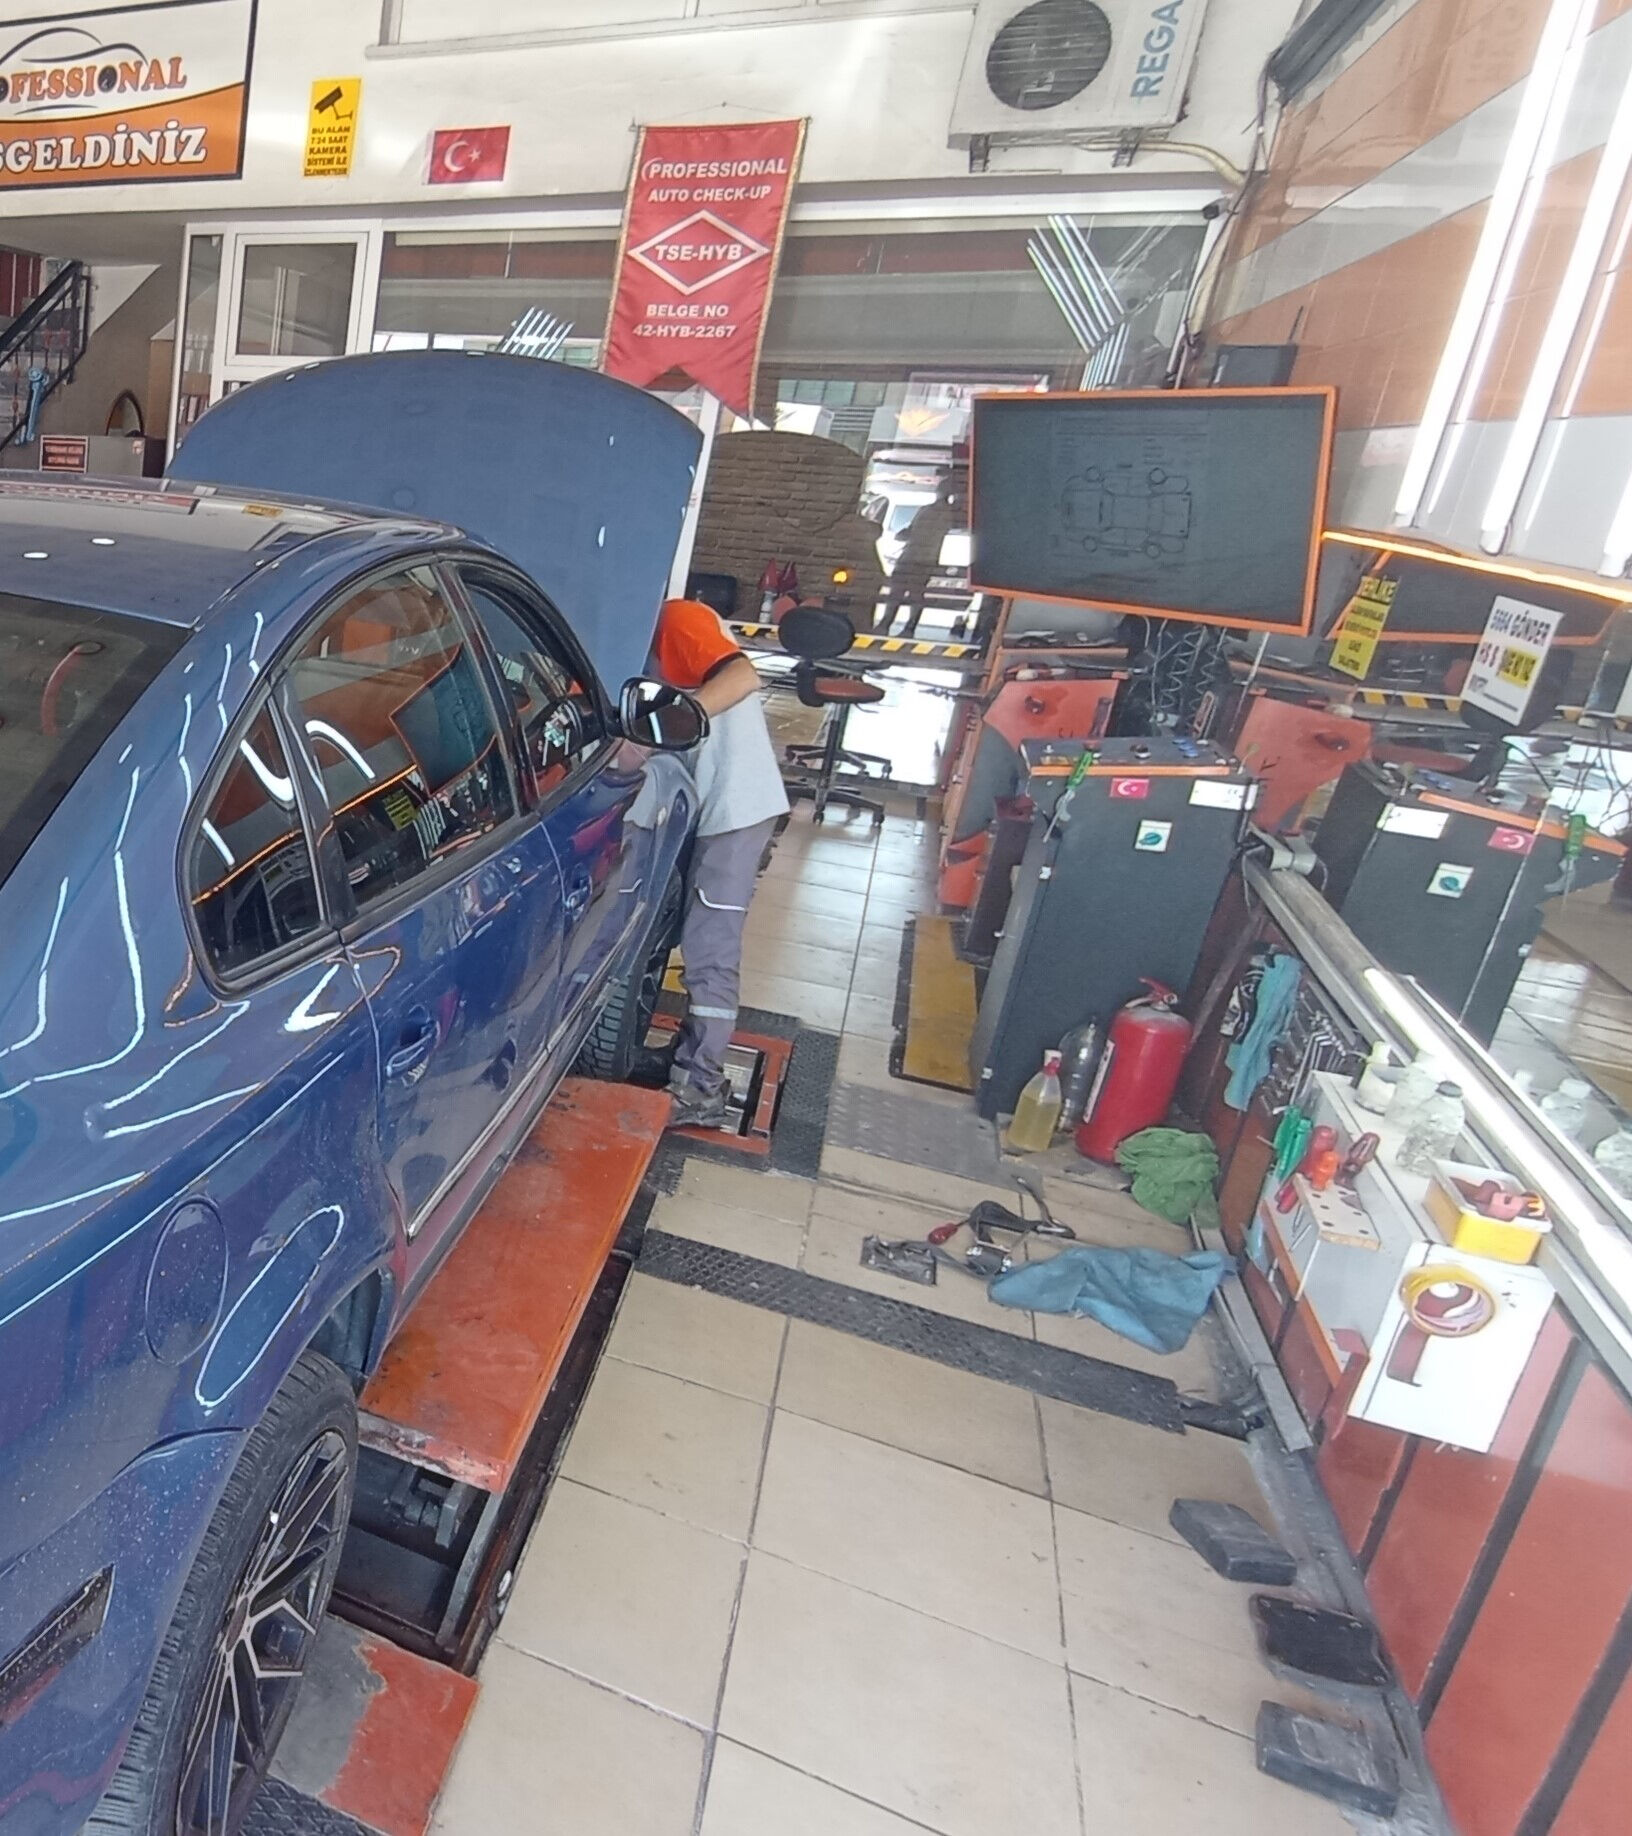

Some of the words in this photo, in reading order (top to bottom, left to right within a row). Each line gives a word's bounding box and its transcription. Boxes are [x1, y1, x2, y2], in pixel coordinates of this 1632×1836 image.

[1130, 0, 1184, 97] REGA
[309, 146, 347, 155] KAMERA
[648, 158, 788, 179] PROFESSIONAL
[648, 188, 689, 203] AUTO
[693, 185, 772, 202] CHECK-UP
[654, 243, 743, 261] TSE-HYB
[646, 304, 699, 318] BELGE
[704, 304, 730, 318] NO
[632, 323, 737, 338] 42-HYB-2267
